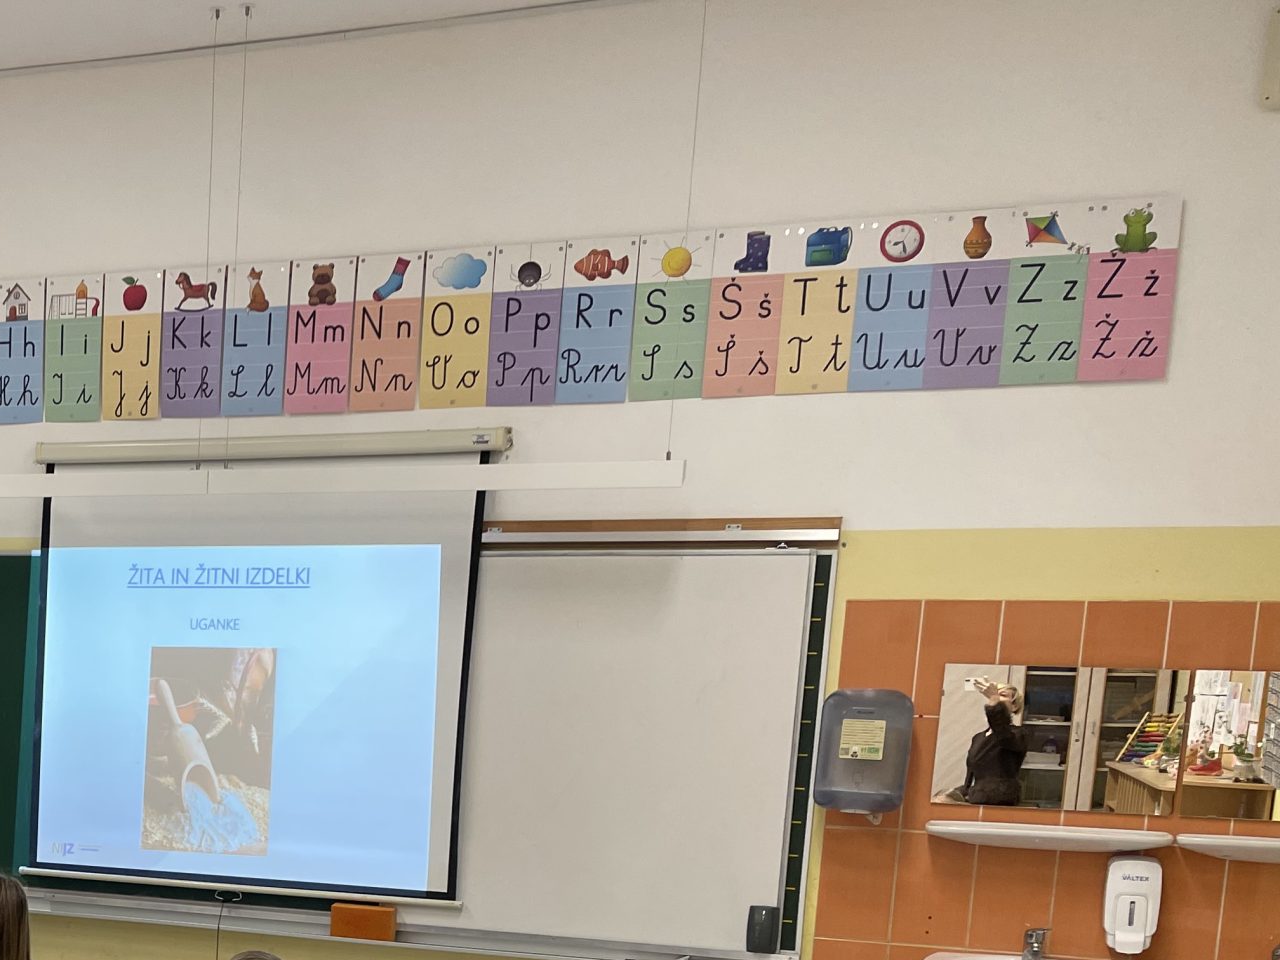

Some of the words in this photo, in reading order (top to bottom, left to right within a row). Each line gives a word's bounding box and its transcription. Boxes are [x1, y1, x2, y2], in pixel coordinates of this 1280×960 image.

[128, 563, 165, 586] ŽITA
[171, 568, 189, 585] IN
[195, 563, 239, 585] ŽITNI
[246, 567, 310, 585] IZDELKI
[189, 618, 240, 631] UGANKE
